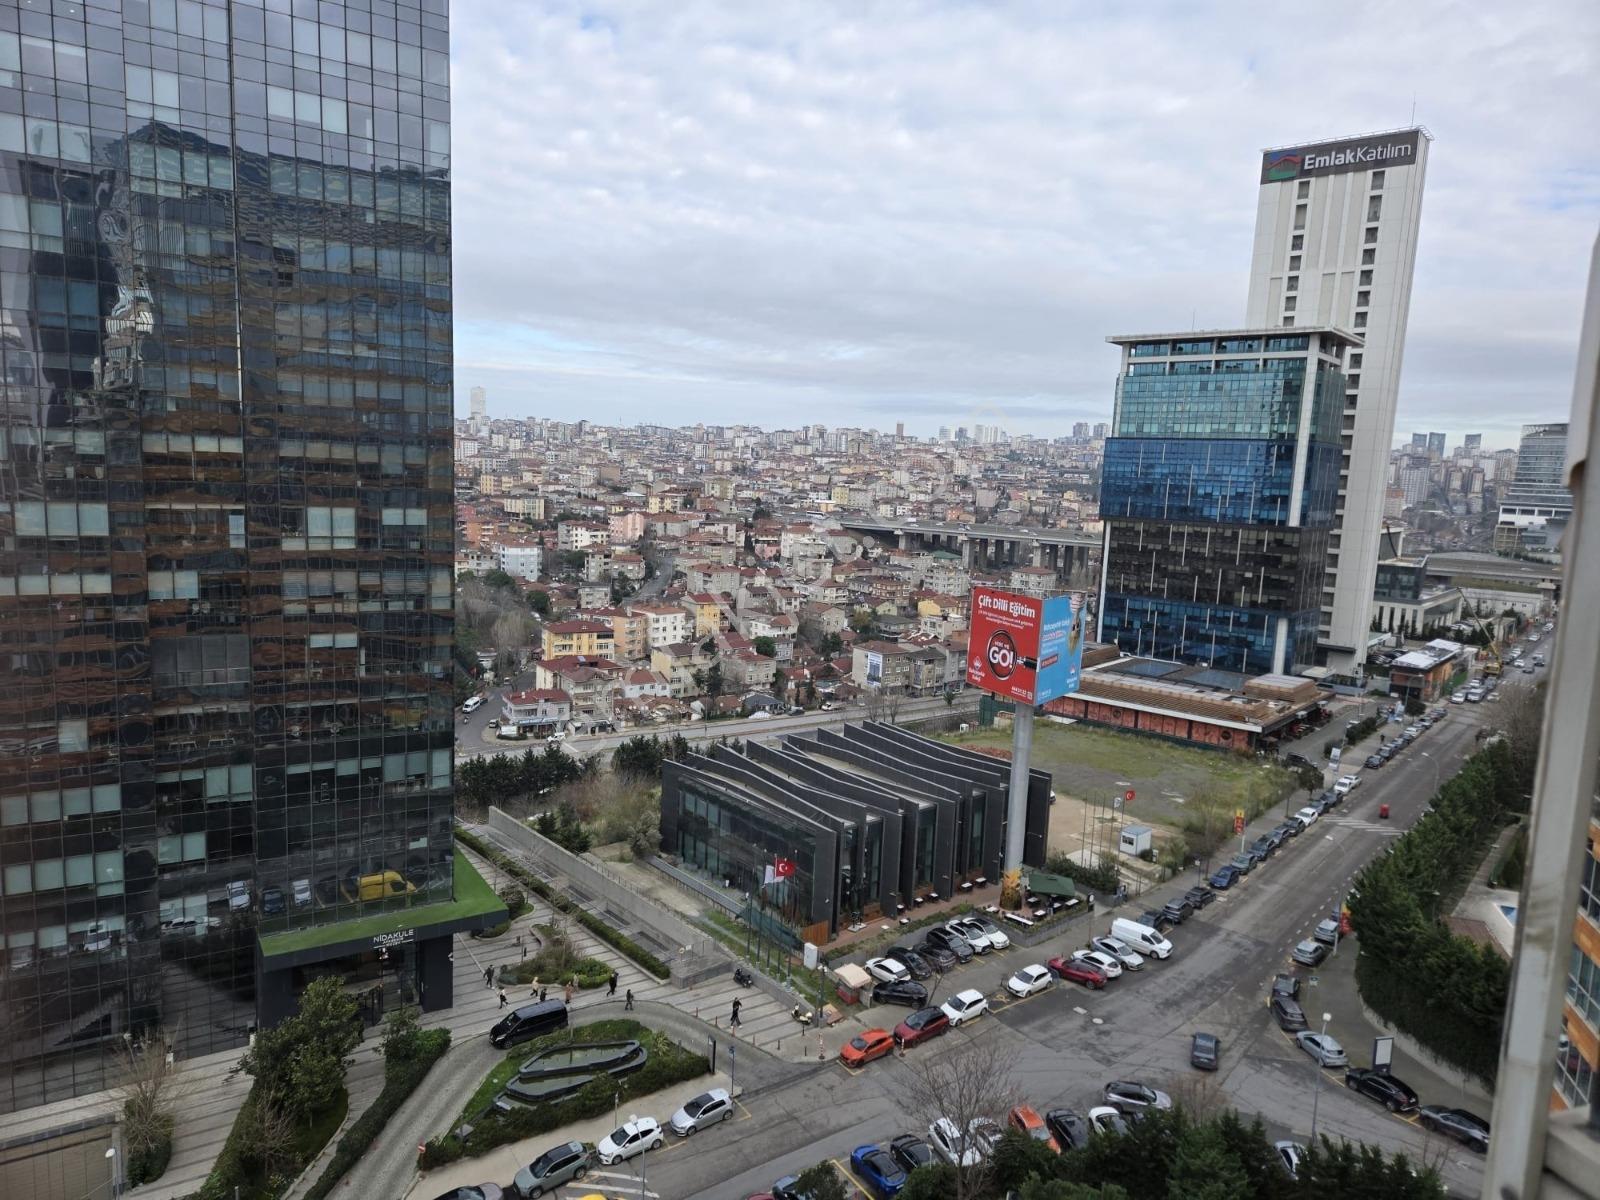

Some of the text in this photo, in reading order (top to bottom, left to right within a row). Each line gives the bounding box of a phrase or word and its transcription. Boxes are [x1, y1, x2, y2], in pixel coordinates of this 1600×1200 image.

[1303, 143, 1412, 170] EmlakKatılım
[978, 594, 992, 609] Çift
[993, 597, 1008, 612] Dilli
[1009, 601, 1036, 618] Eğitim
[989, 646, 1014, 669] GO!
